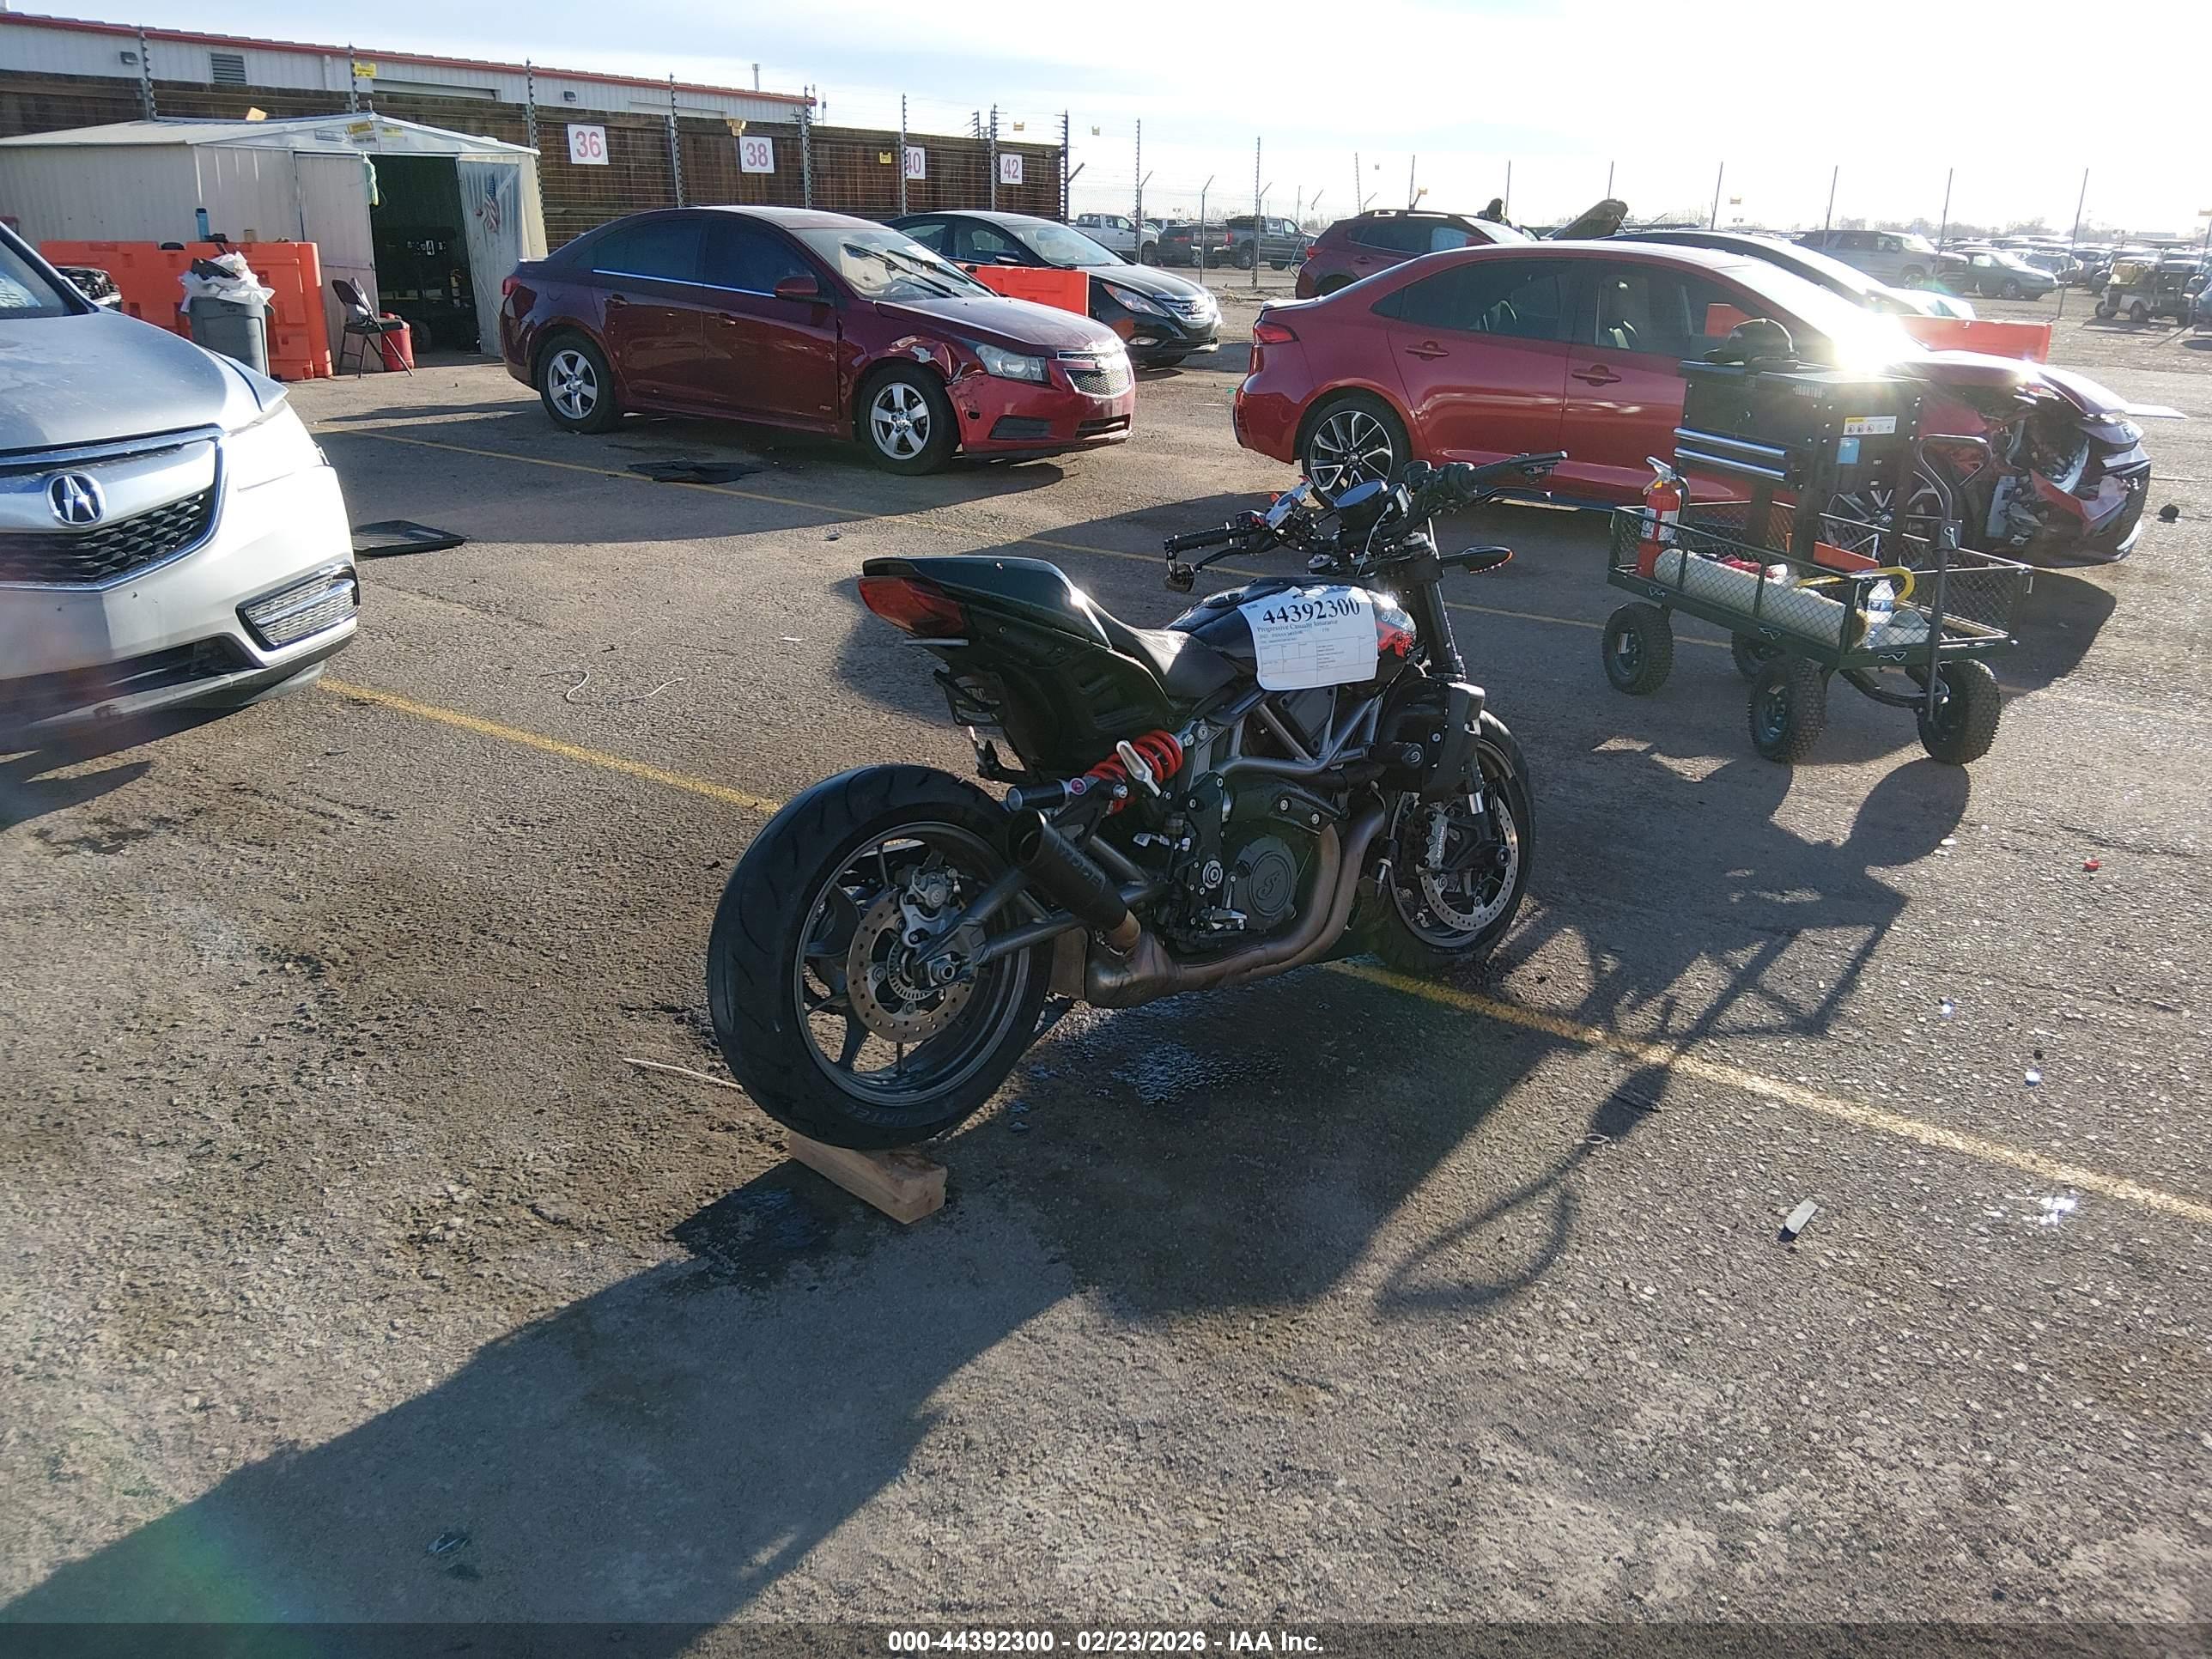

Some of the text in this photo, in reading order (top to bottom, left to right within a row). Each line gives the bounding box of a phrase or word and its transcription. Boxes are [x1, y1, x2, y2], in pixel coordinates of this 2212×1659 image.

[575, 131, 602, 158] 36
[745, 142, 769, 167] 38
[1004, 159, 1019, 179] 42
[1262, 597, 1360, 624] 44392300
[1256, 623, 1289, 633] Progressive
[1290, 621, 1313, 630] Casualty
